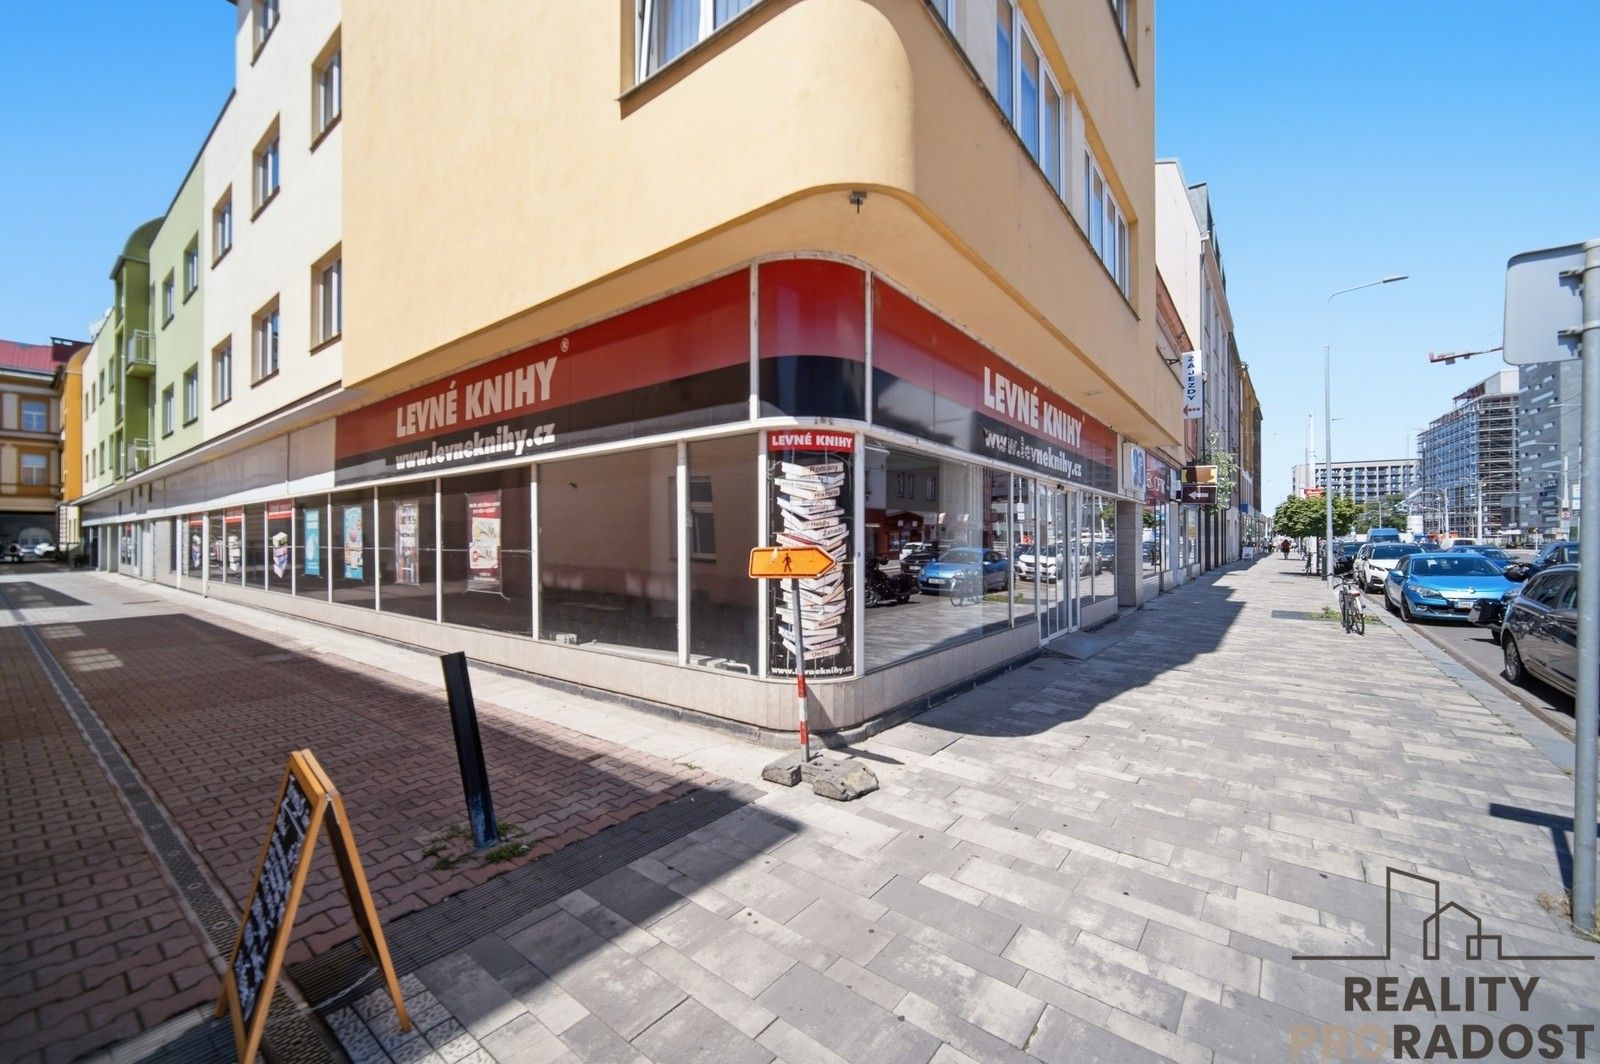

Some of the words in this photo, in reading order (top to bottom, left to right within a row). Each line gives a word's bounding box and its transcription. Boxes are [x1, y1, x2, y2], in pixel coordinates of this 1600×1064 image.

[396, 380, 457, 438] LEVNÉ
[465, 356, 558, 421] KNIHY
[983, 365, 1039, 429] LEVNÉ
[1043, 400, 1082, 449] KNIHY
[396, 423, 556, 470] www.levneknihy.cz
[771, 432, 812, 446] LEVNÉ
[816, 434, 853, 448] KNIHY
